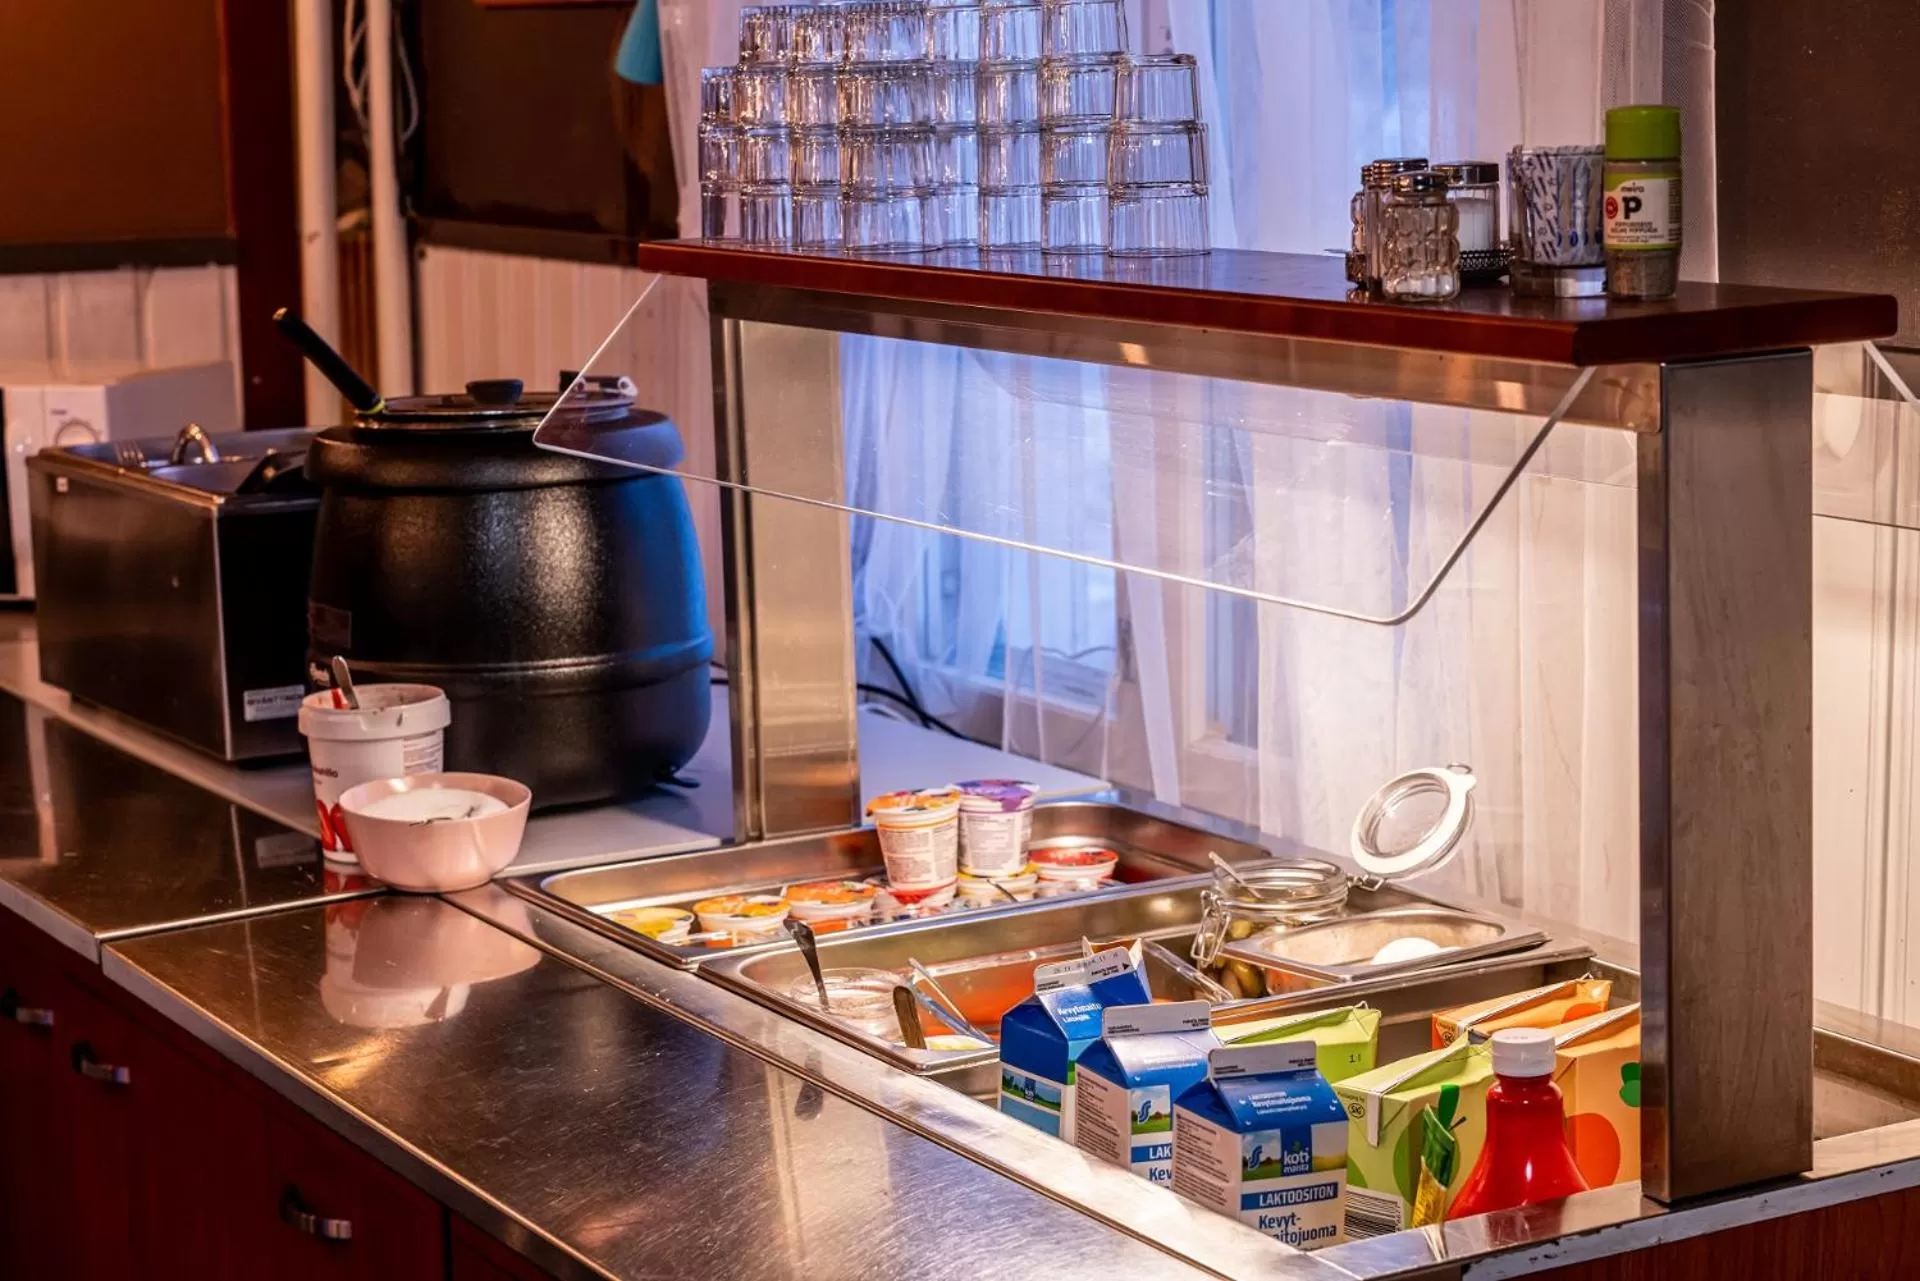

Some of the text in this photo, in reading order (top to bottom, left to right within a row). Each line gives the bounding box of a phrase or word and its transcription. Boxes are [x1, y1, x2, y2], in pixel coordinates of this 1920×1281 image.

[1622, 196, 1642, 220] P
[1283, 1147, 1311, 1164] koti
[1283, 1163, 1310, 1174] maista
[1260, 1184, 1335, 1208] LAKTOOSITON
[1259, 1211, 1301, 1233] Kevyt-
